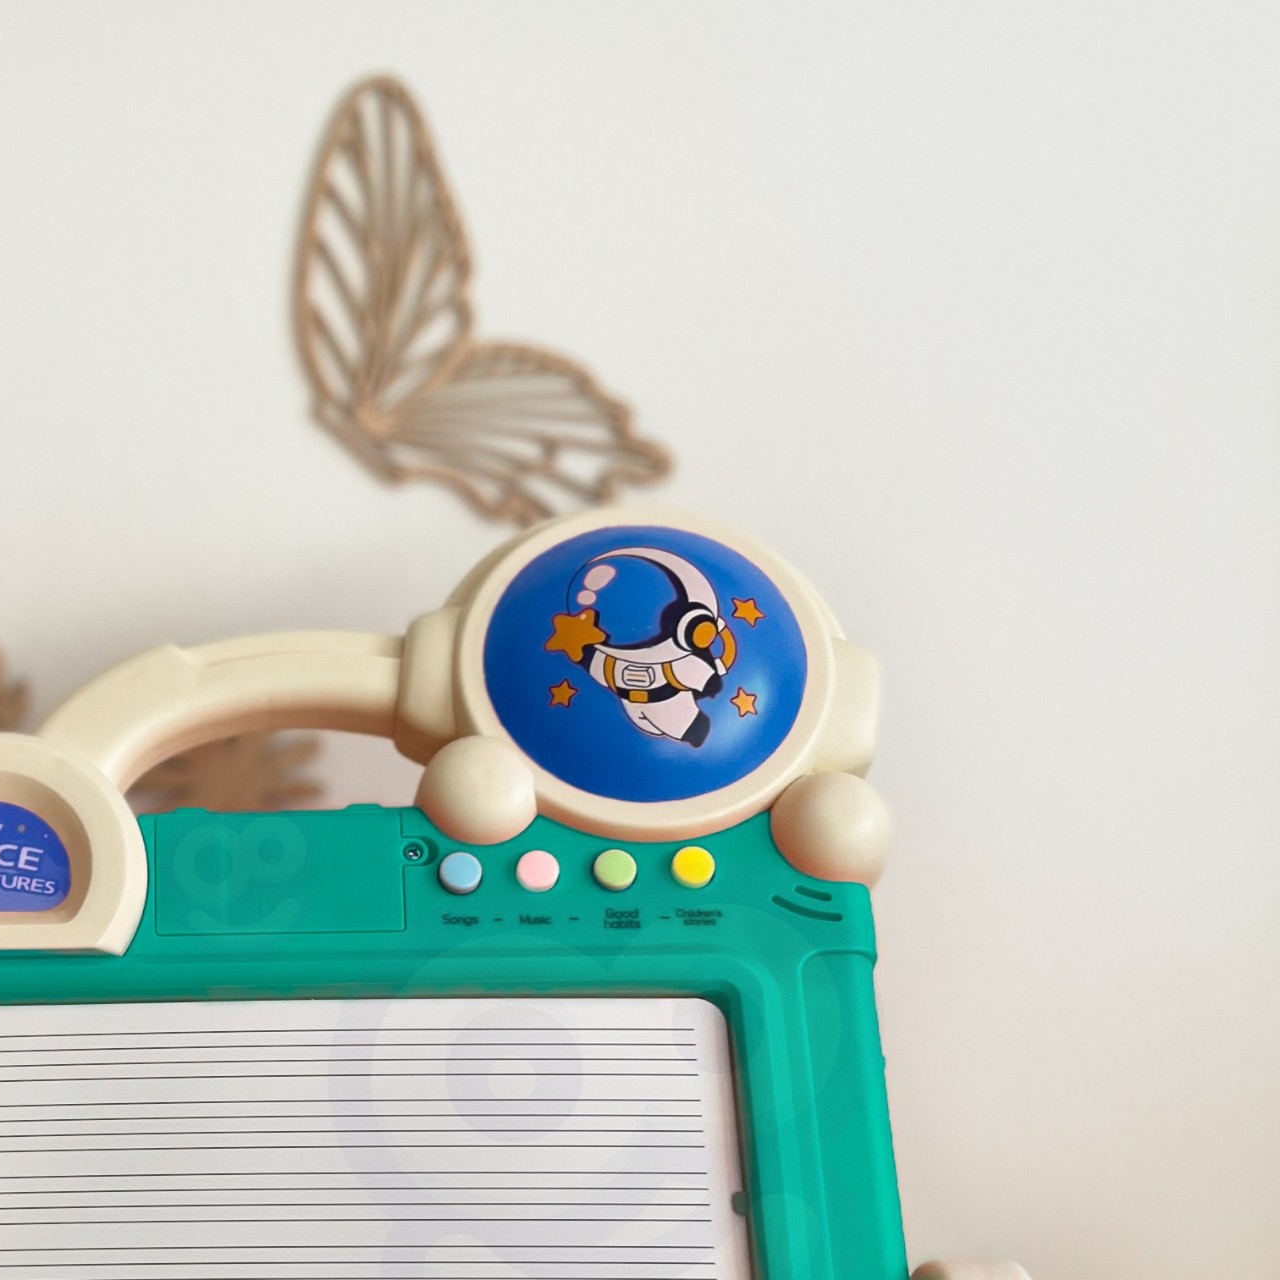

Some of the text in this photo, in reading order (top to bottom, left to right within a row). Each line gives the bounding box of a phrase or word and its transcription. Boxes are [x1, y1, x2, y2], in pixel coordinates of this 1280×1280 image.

[442, 913, 479, 926] Songs
[518, 913, 553, 925] Music
[604, 908, 639, 919] Good
